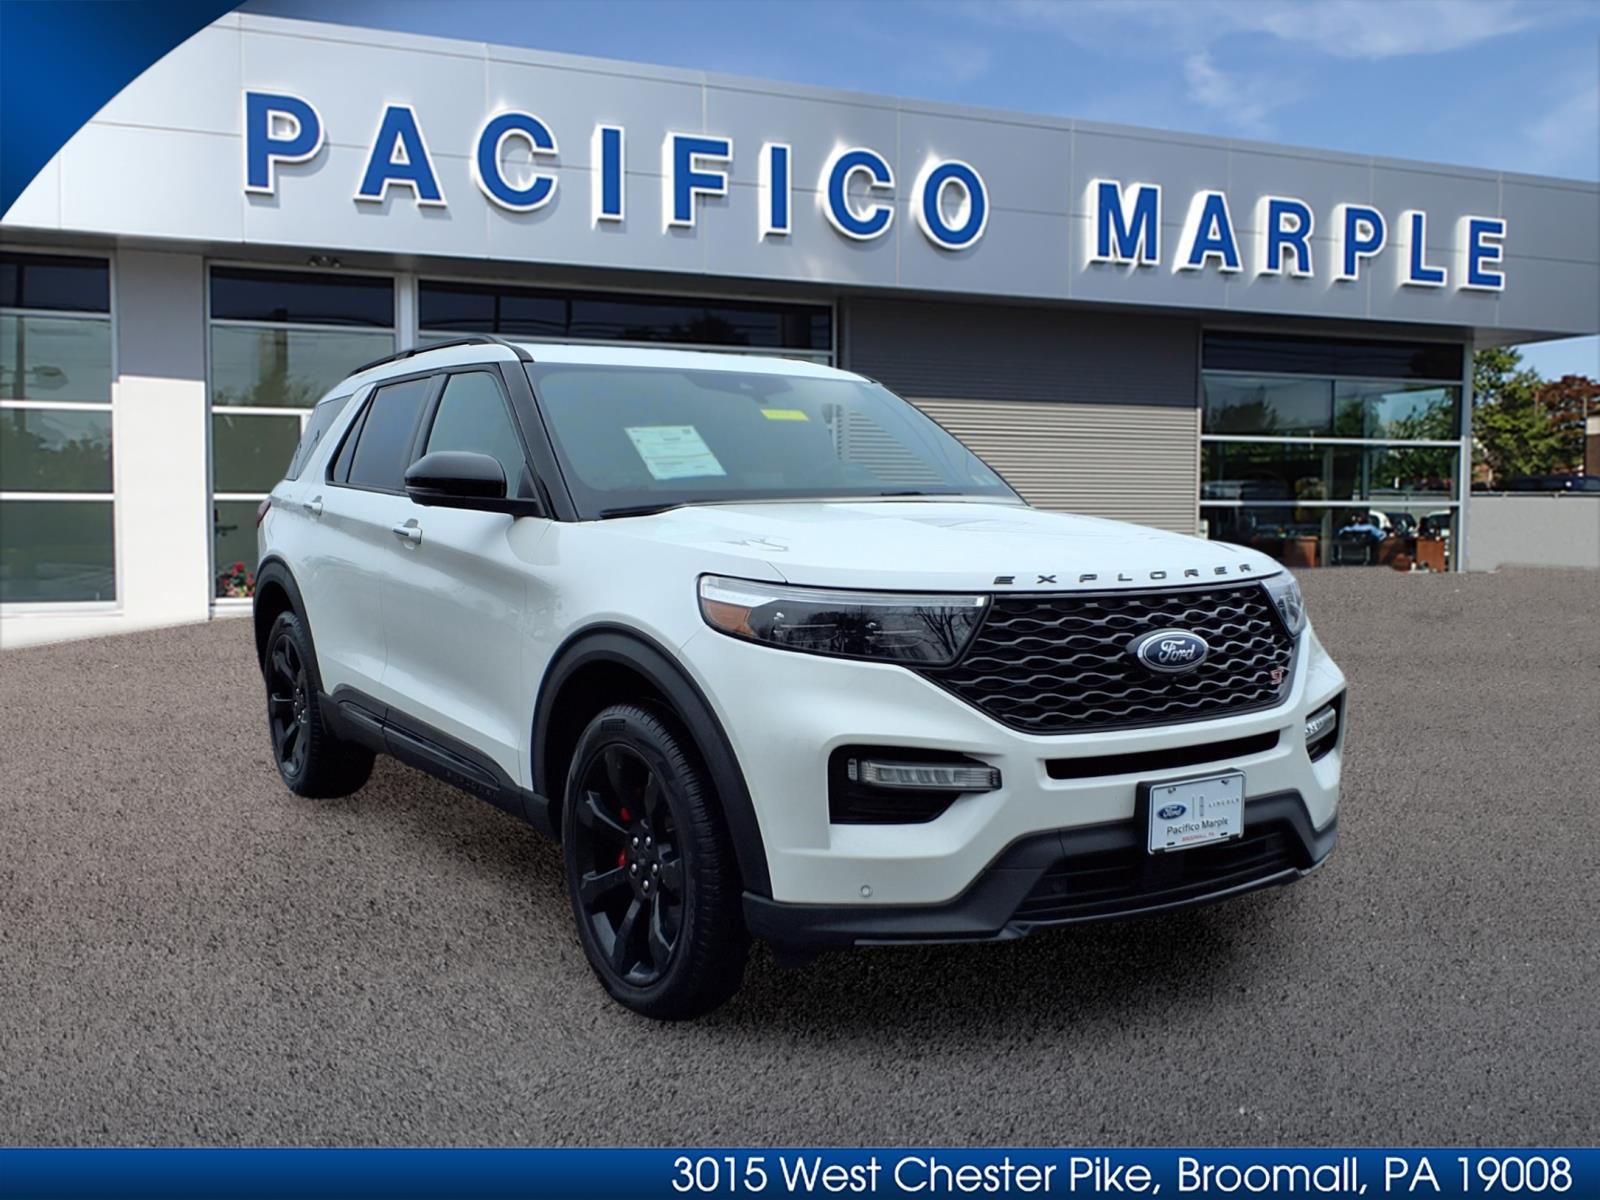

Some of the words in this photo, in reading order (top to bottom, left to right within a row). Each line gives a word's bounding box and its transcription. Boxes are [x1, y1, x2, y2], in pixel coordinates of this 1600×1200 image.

[242, 88, 990, 252] PACIFICO
[1084, 178, 1507, 291] MARPLE
[994, 563, 1253, 585] EXPLORER
[1158, 639, 1195, 663] Ford
[1166, 823, 1200, 836] Pacifico
[1201, 818, 1228, 830] Marple
